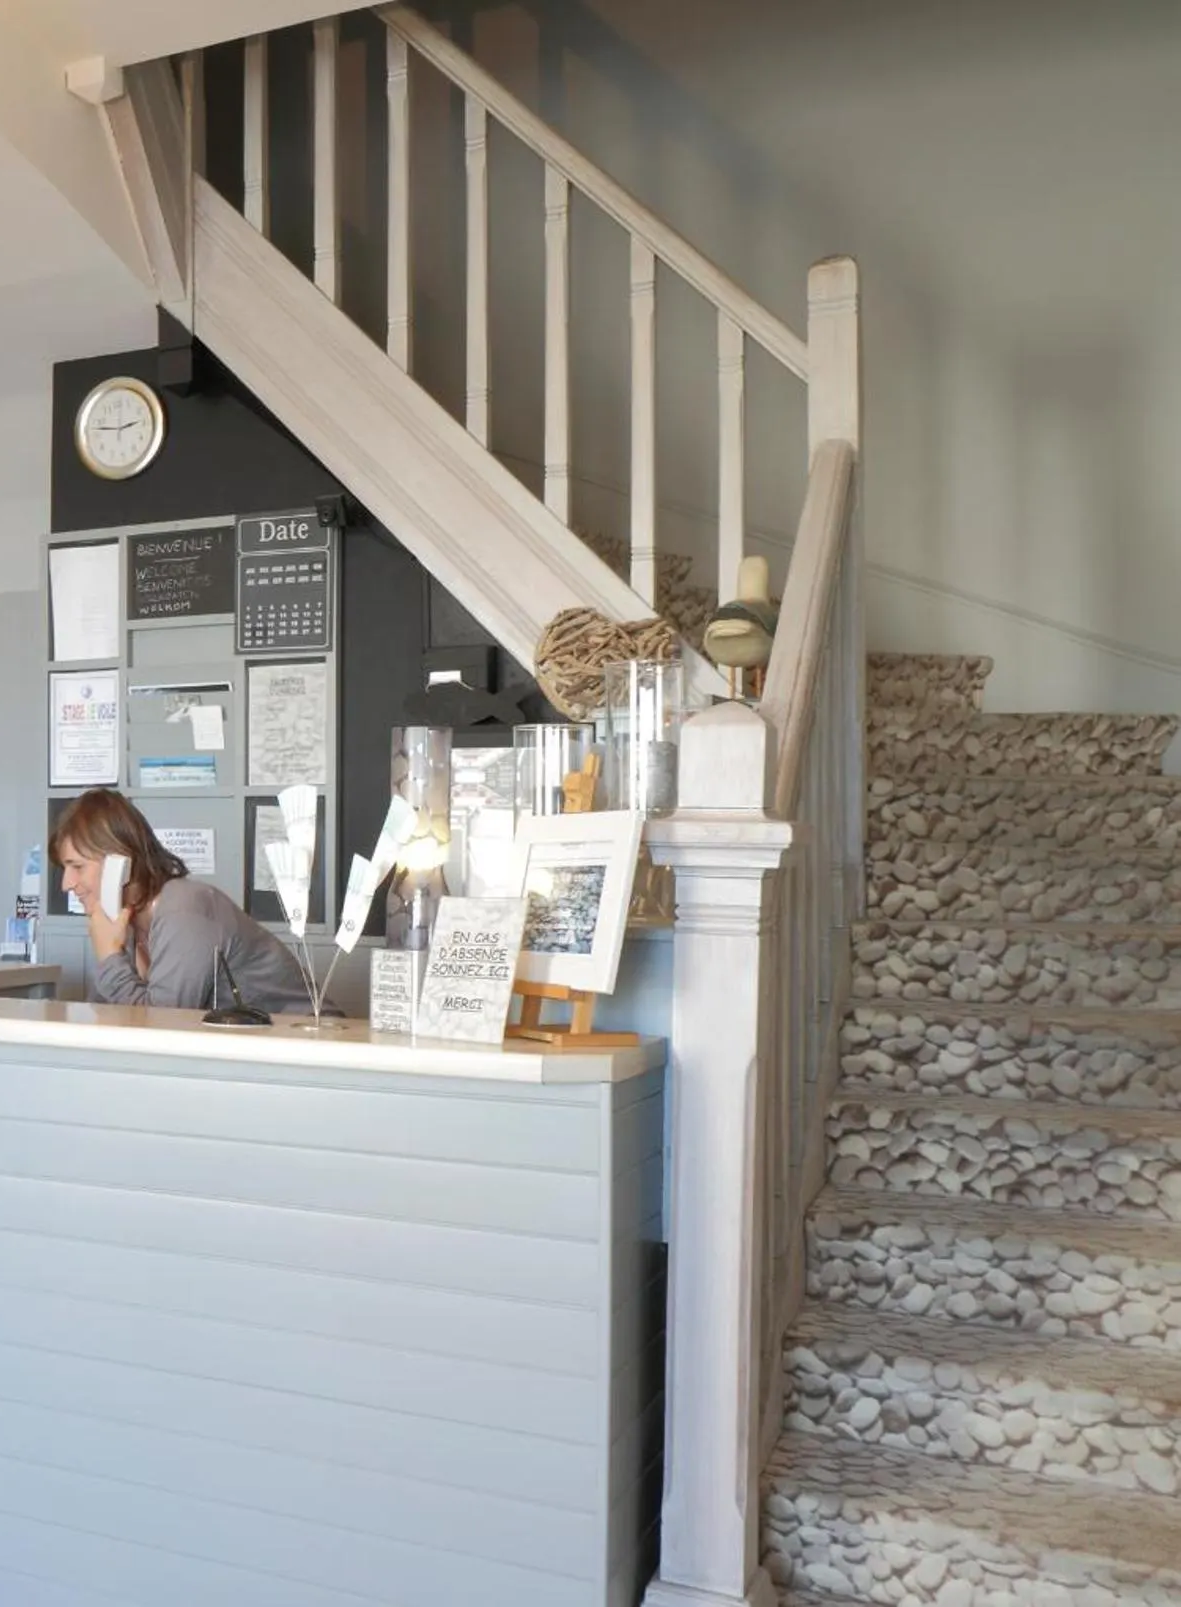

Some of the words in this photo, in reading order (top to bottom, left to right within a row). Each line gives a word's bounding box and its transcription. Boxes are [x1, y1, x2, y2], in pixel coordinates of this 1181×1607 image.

[259, 519, 309, 542] Date
[136, 535, 213, 556] BIENVENUE
[452, 931, 471, 943] EN
[474, 932, 501, 944] CAS
[439, 947, 509, 961] D'ABSENCE
[431, 963, 484, 977] SONNEZ
[489, 965, 510, 978] ICI
[442, 997, 485, 1010] MERCI
